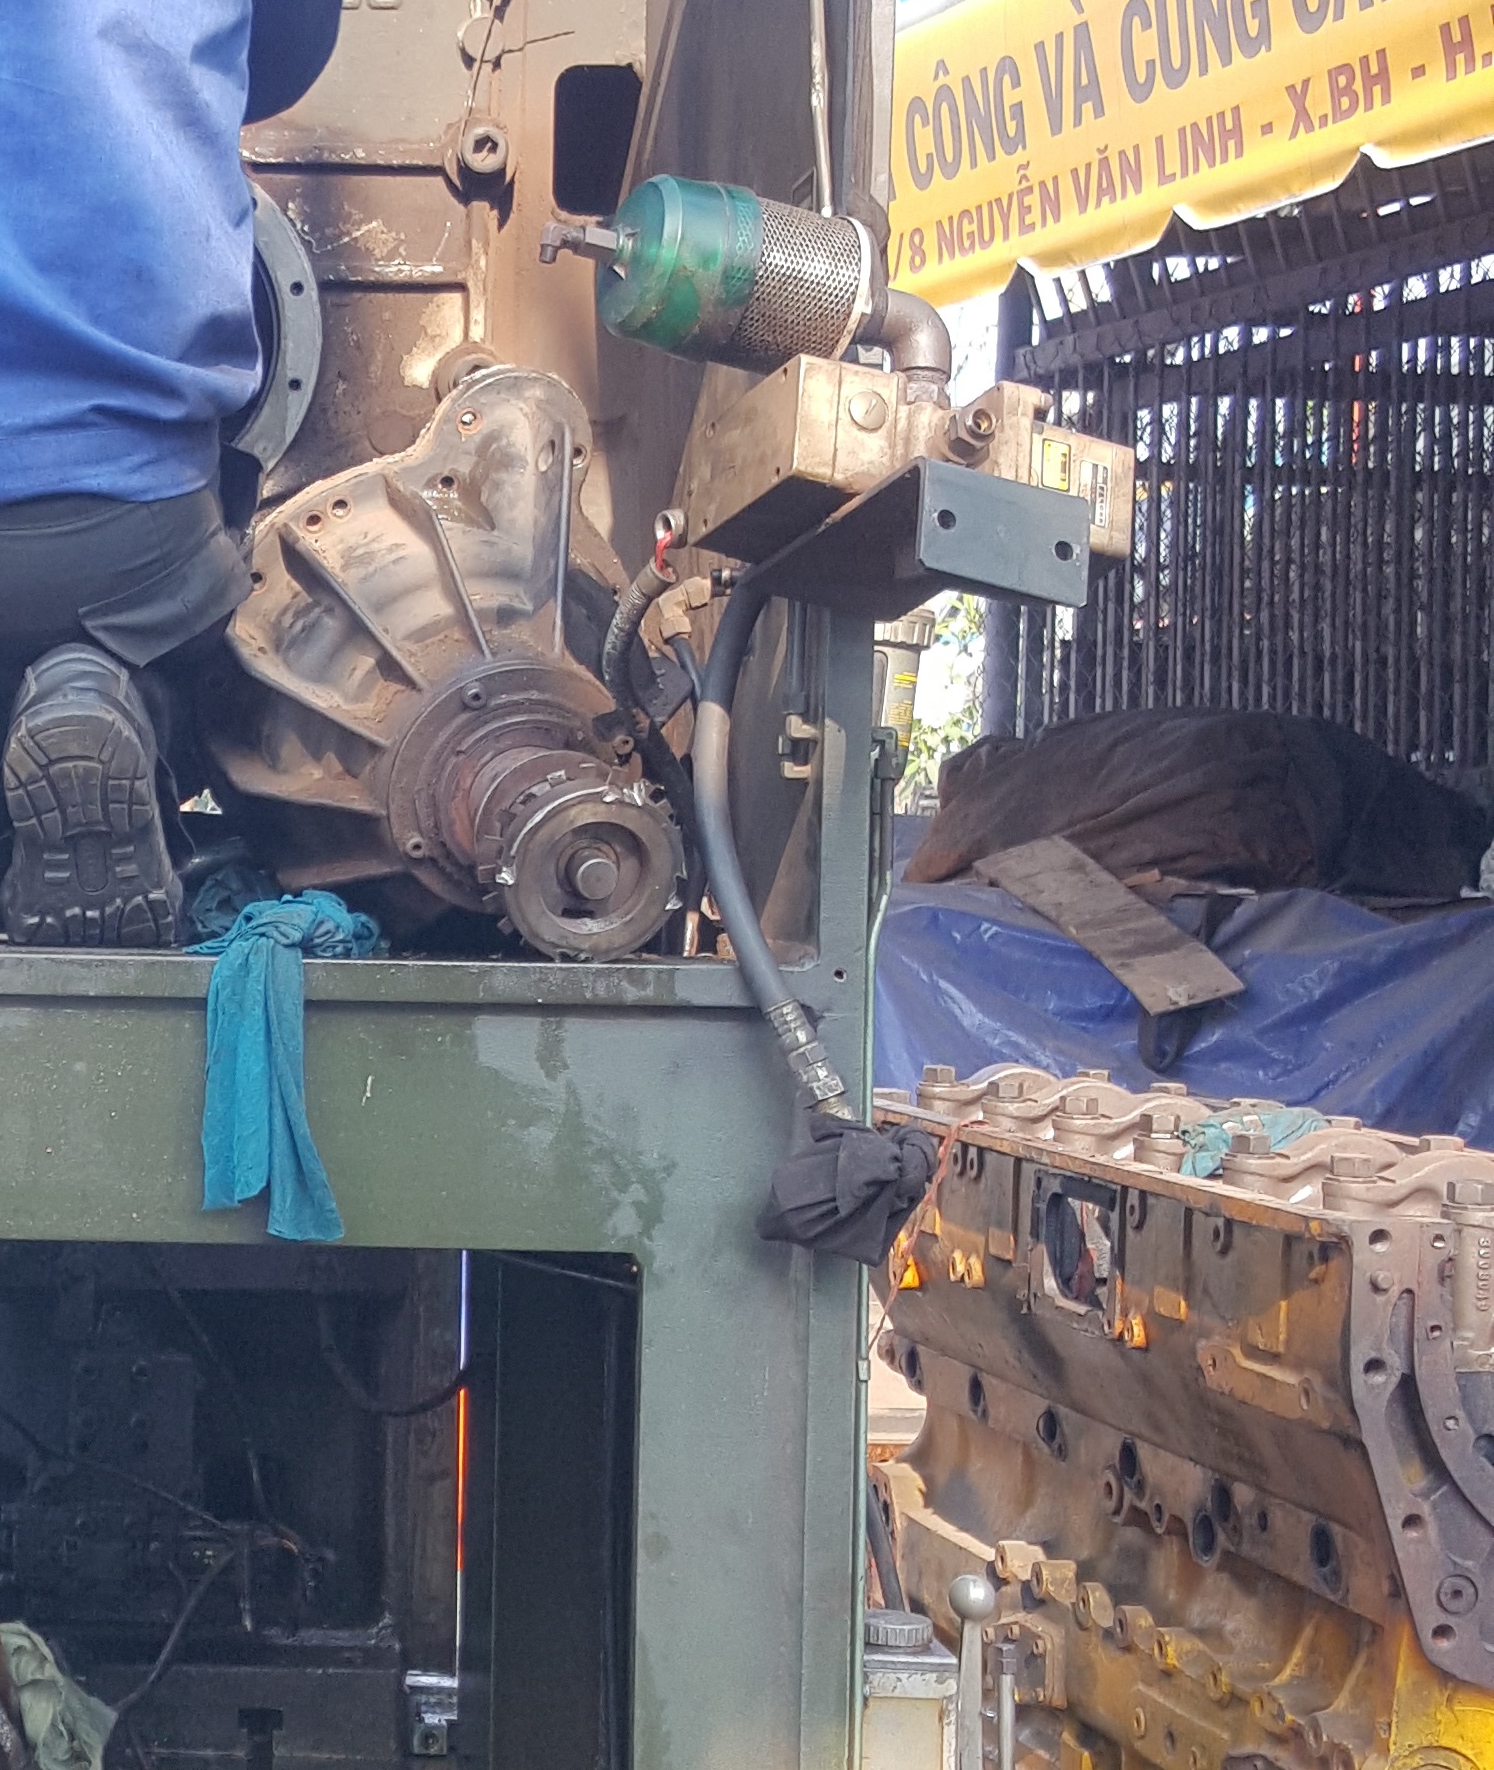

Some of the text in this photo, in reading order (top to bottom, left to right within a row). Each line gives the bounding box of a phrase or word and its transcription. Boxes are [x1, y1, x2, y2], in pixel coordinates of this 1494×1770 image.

[905, 59, 1027, 192] CÔNG
[935, 160, 1061, 266] NGUYỄN
[1071, 143, 1143, 216] VĂN
[1154, 105, 1244, 188] LINH
[1285, 47, 1392, 141] X.BH
[1439, 3, 1494, 82] H.
